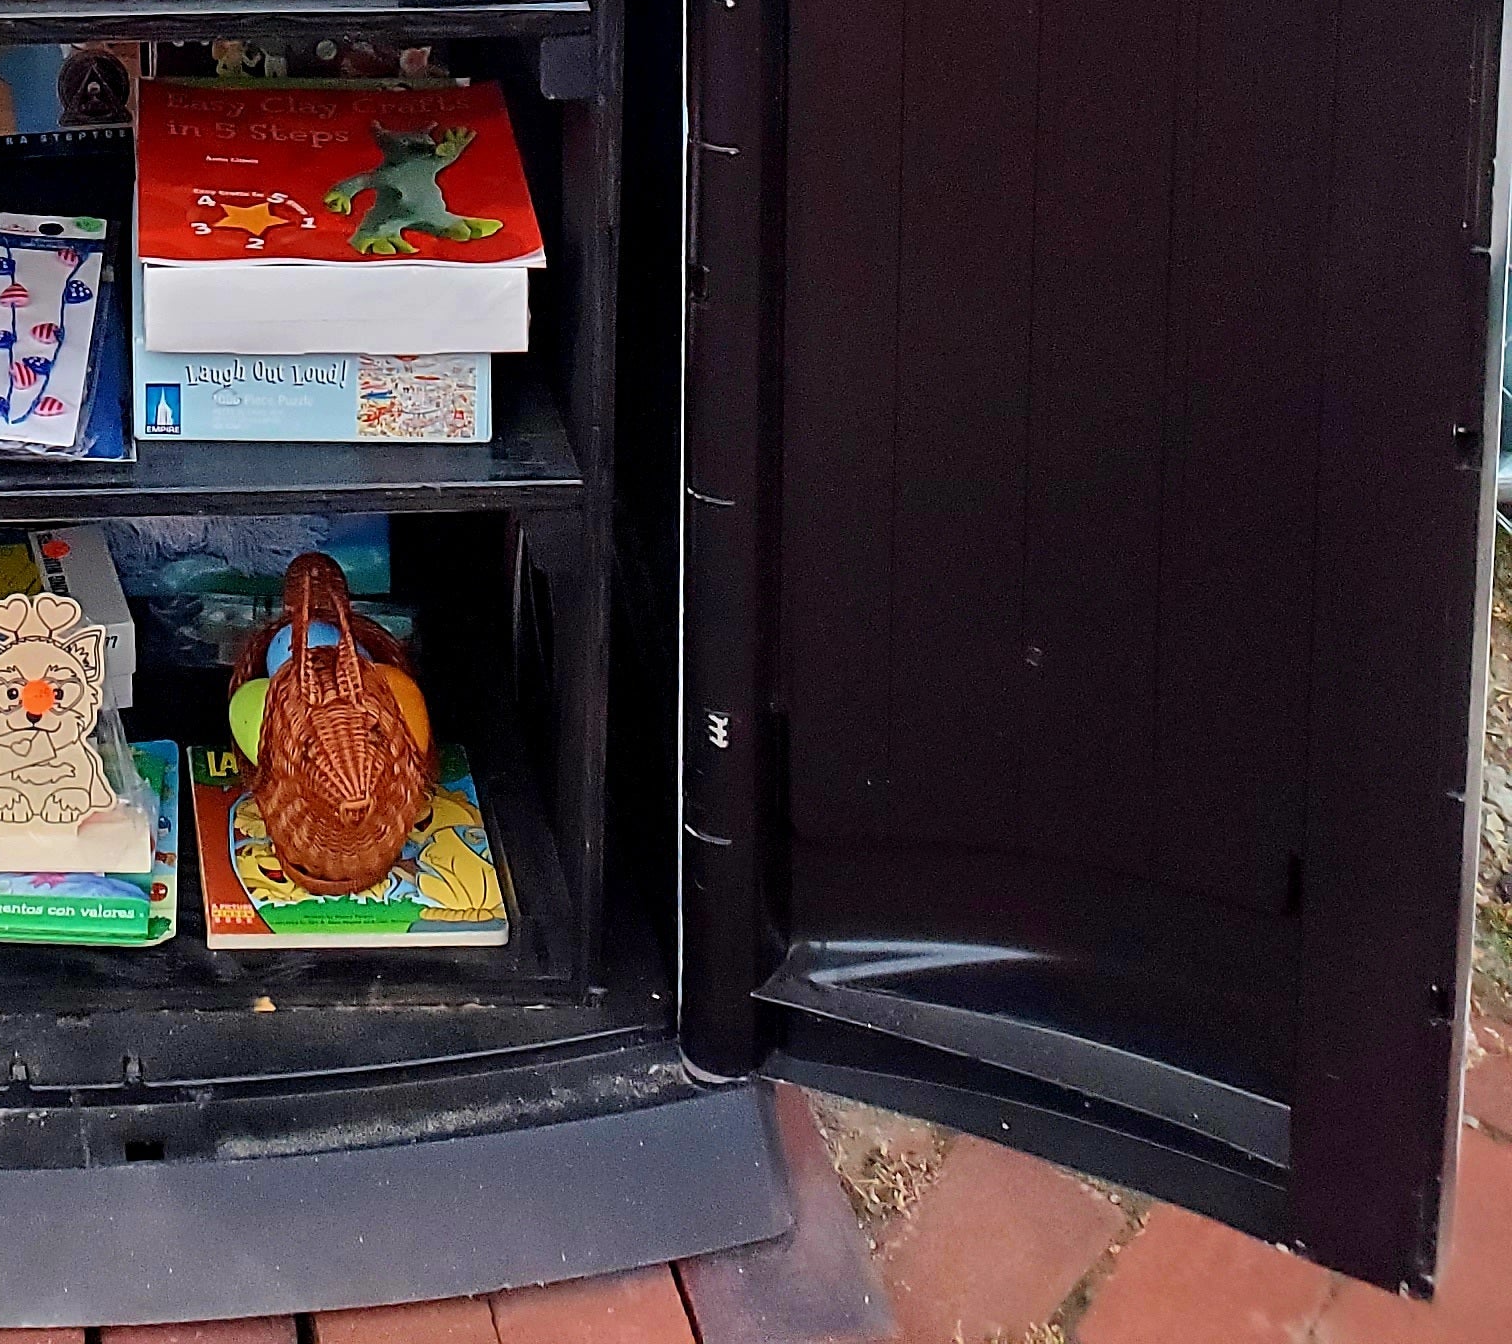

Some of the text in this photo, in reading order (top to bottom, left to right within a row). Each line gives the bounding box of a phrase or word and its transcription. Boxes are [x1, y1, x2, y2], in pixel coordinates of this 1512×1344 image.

[168, 93, 244, 117] Easy
[261, 97, 337, 119] Clay
[168, 120, 349, 148] in 5 Steps
[185, 360, 349, 389] Laugh Out Loud!
[146, 426, 180, 434] EMPIRE
[48, 904, 75, 917] con
[80, 903, 135, 919] valores
